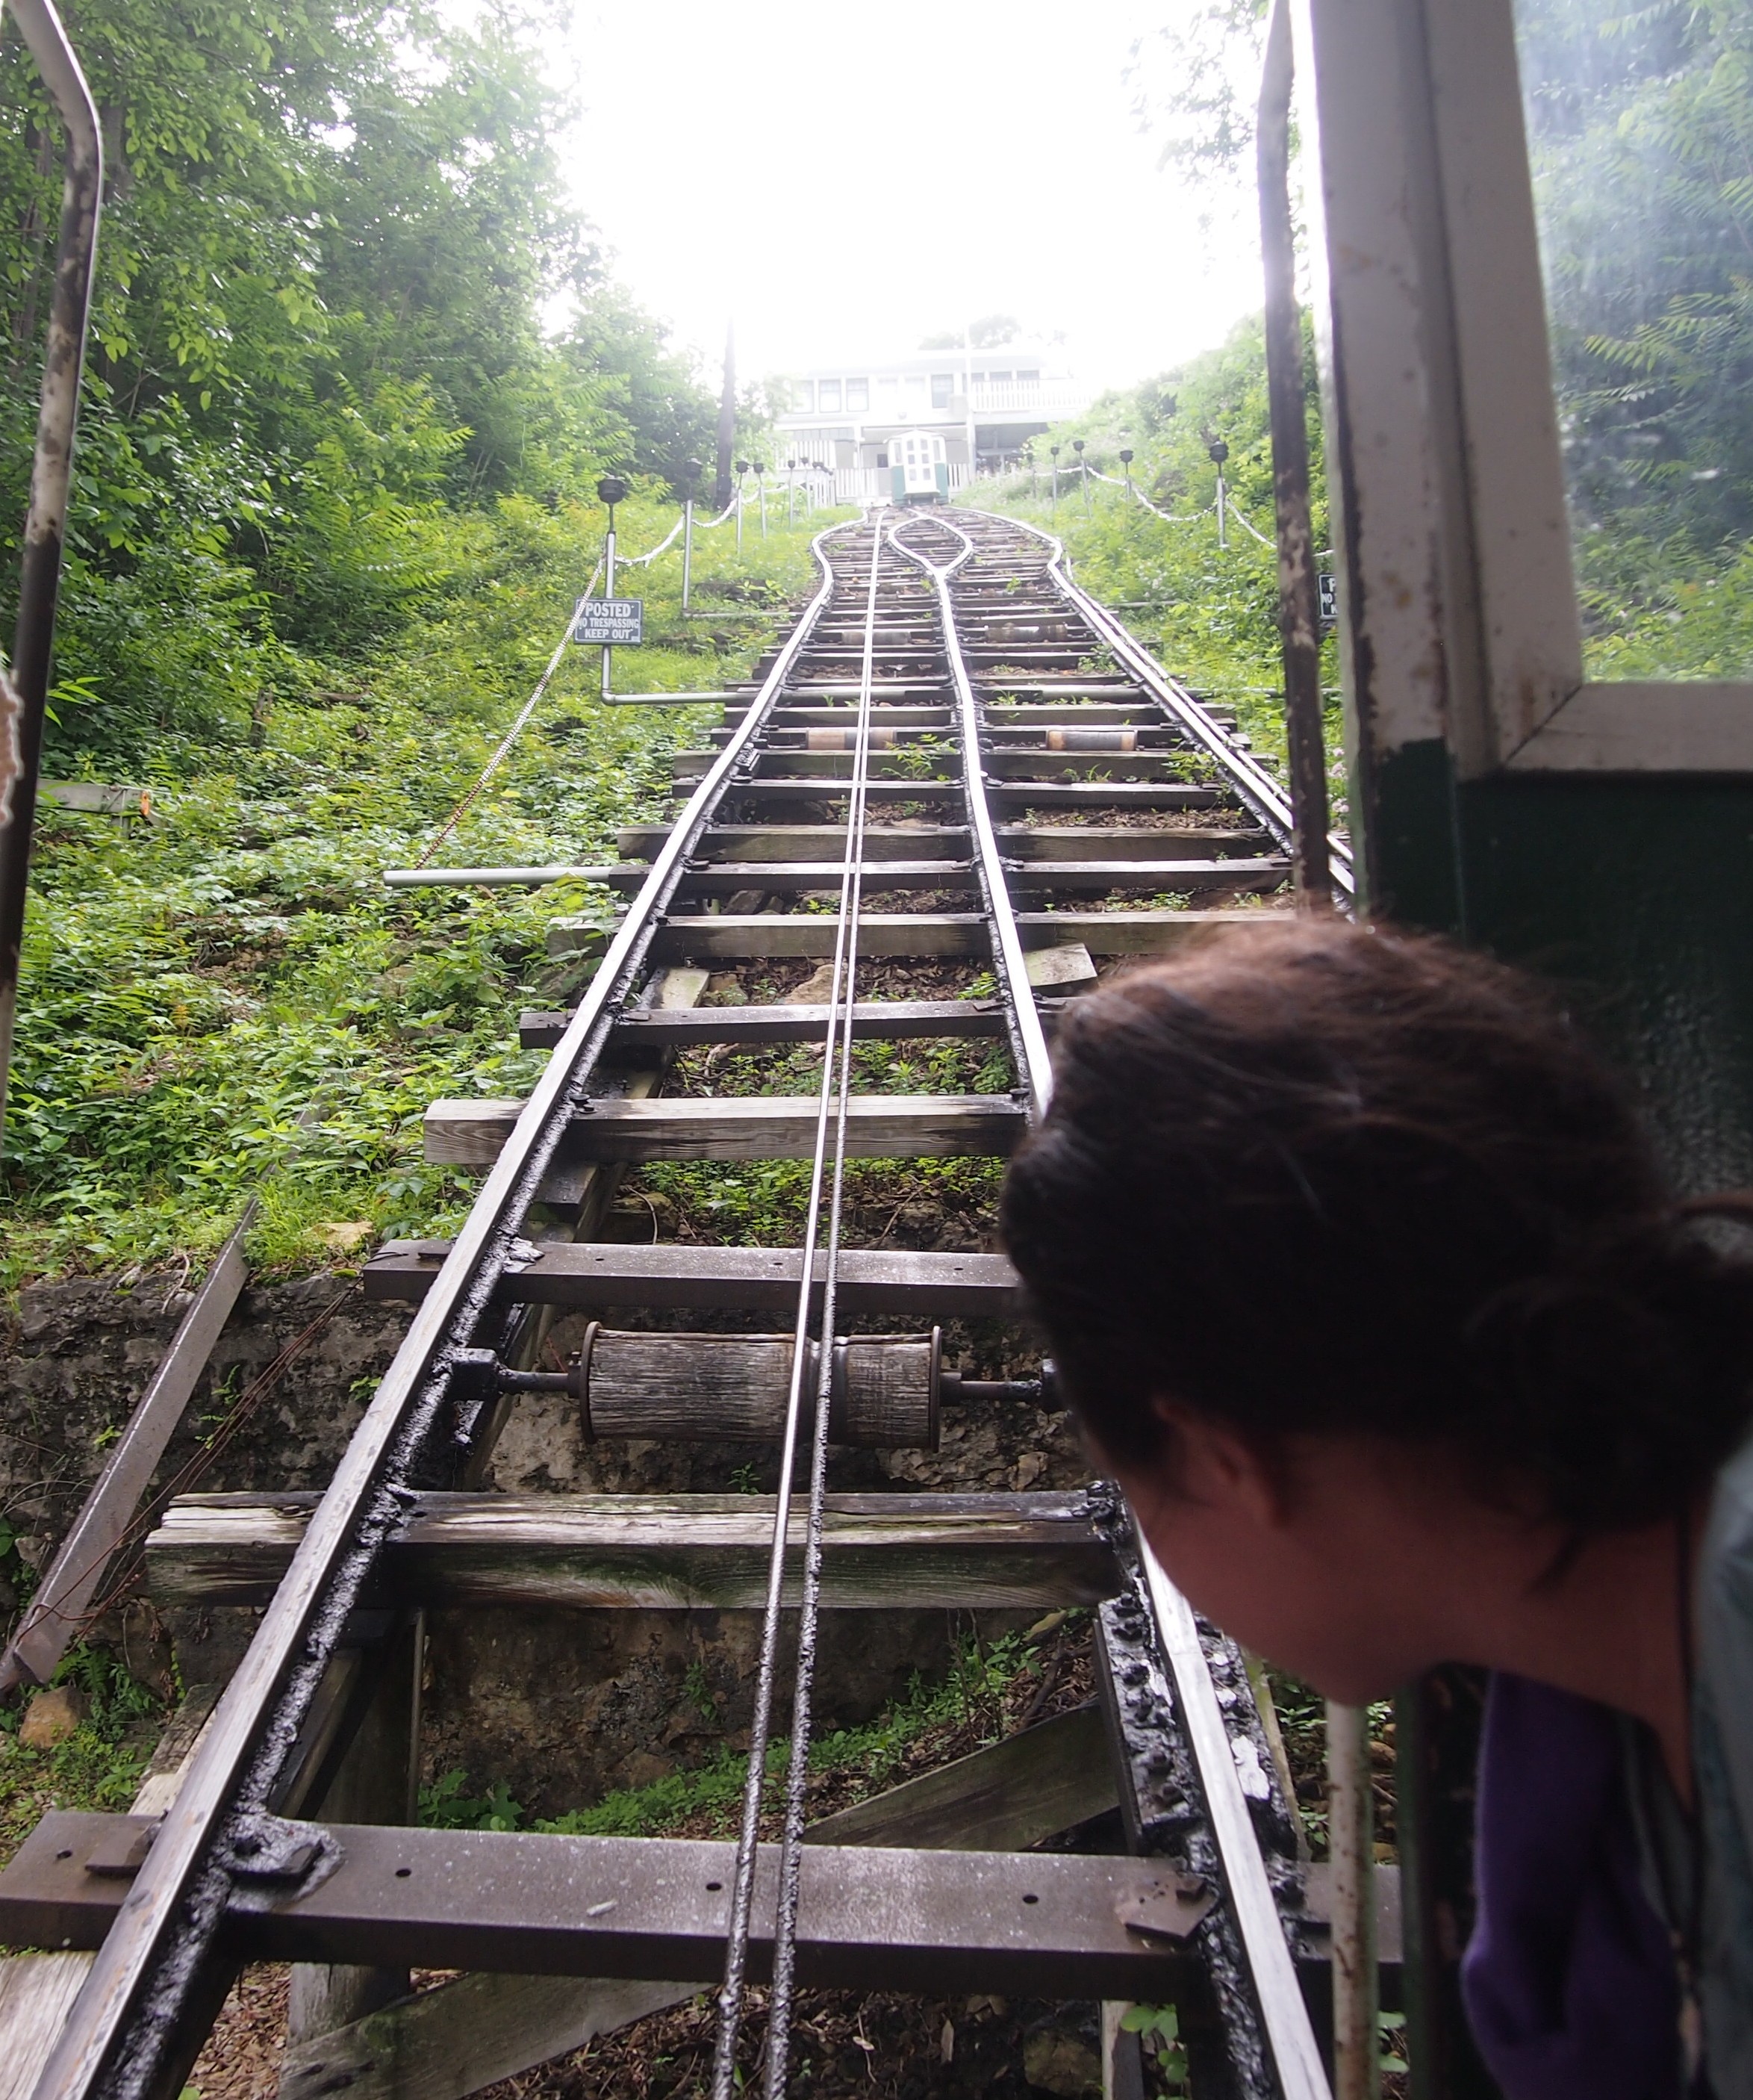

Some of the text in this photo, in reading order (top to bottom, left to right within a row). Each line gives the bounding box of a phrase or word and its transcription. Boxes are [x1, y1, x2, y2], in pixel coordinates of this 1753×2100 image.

[585, 603, 631, 617] POSTED
[577, 618, 639, 628] NO TRESPASSING
[585, 628, 608, 639] KEEP
[612, 629, 629, 639] OUT
